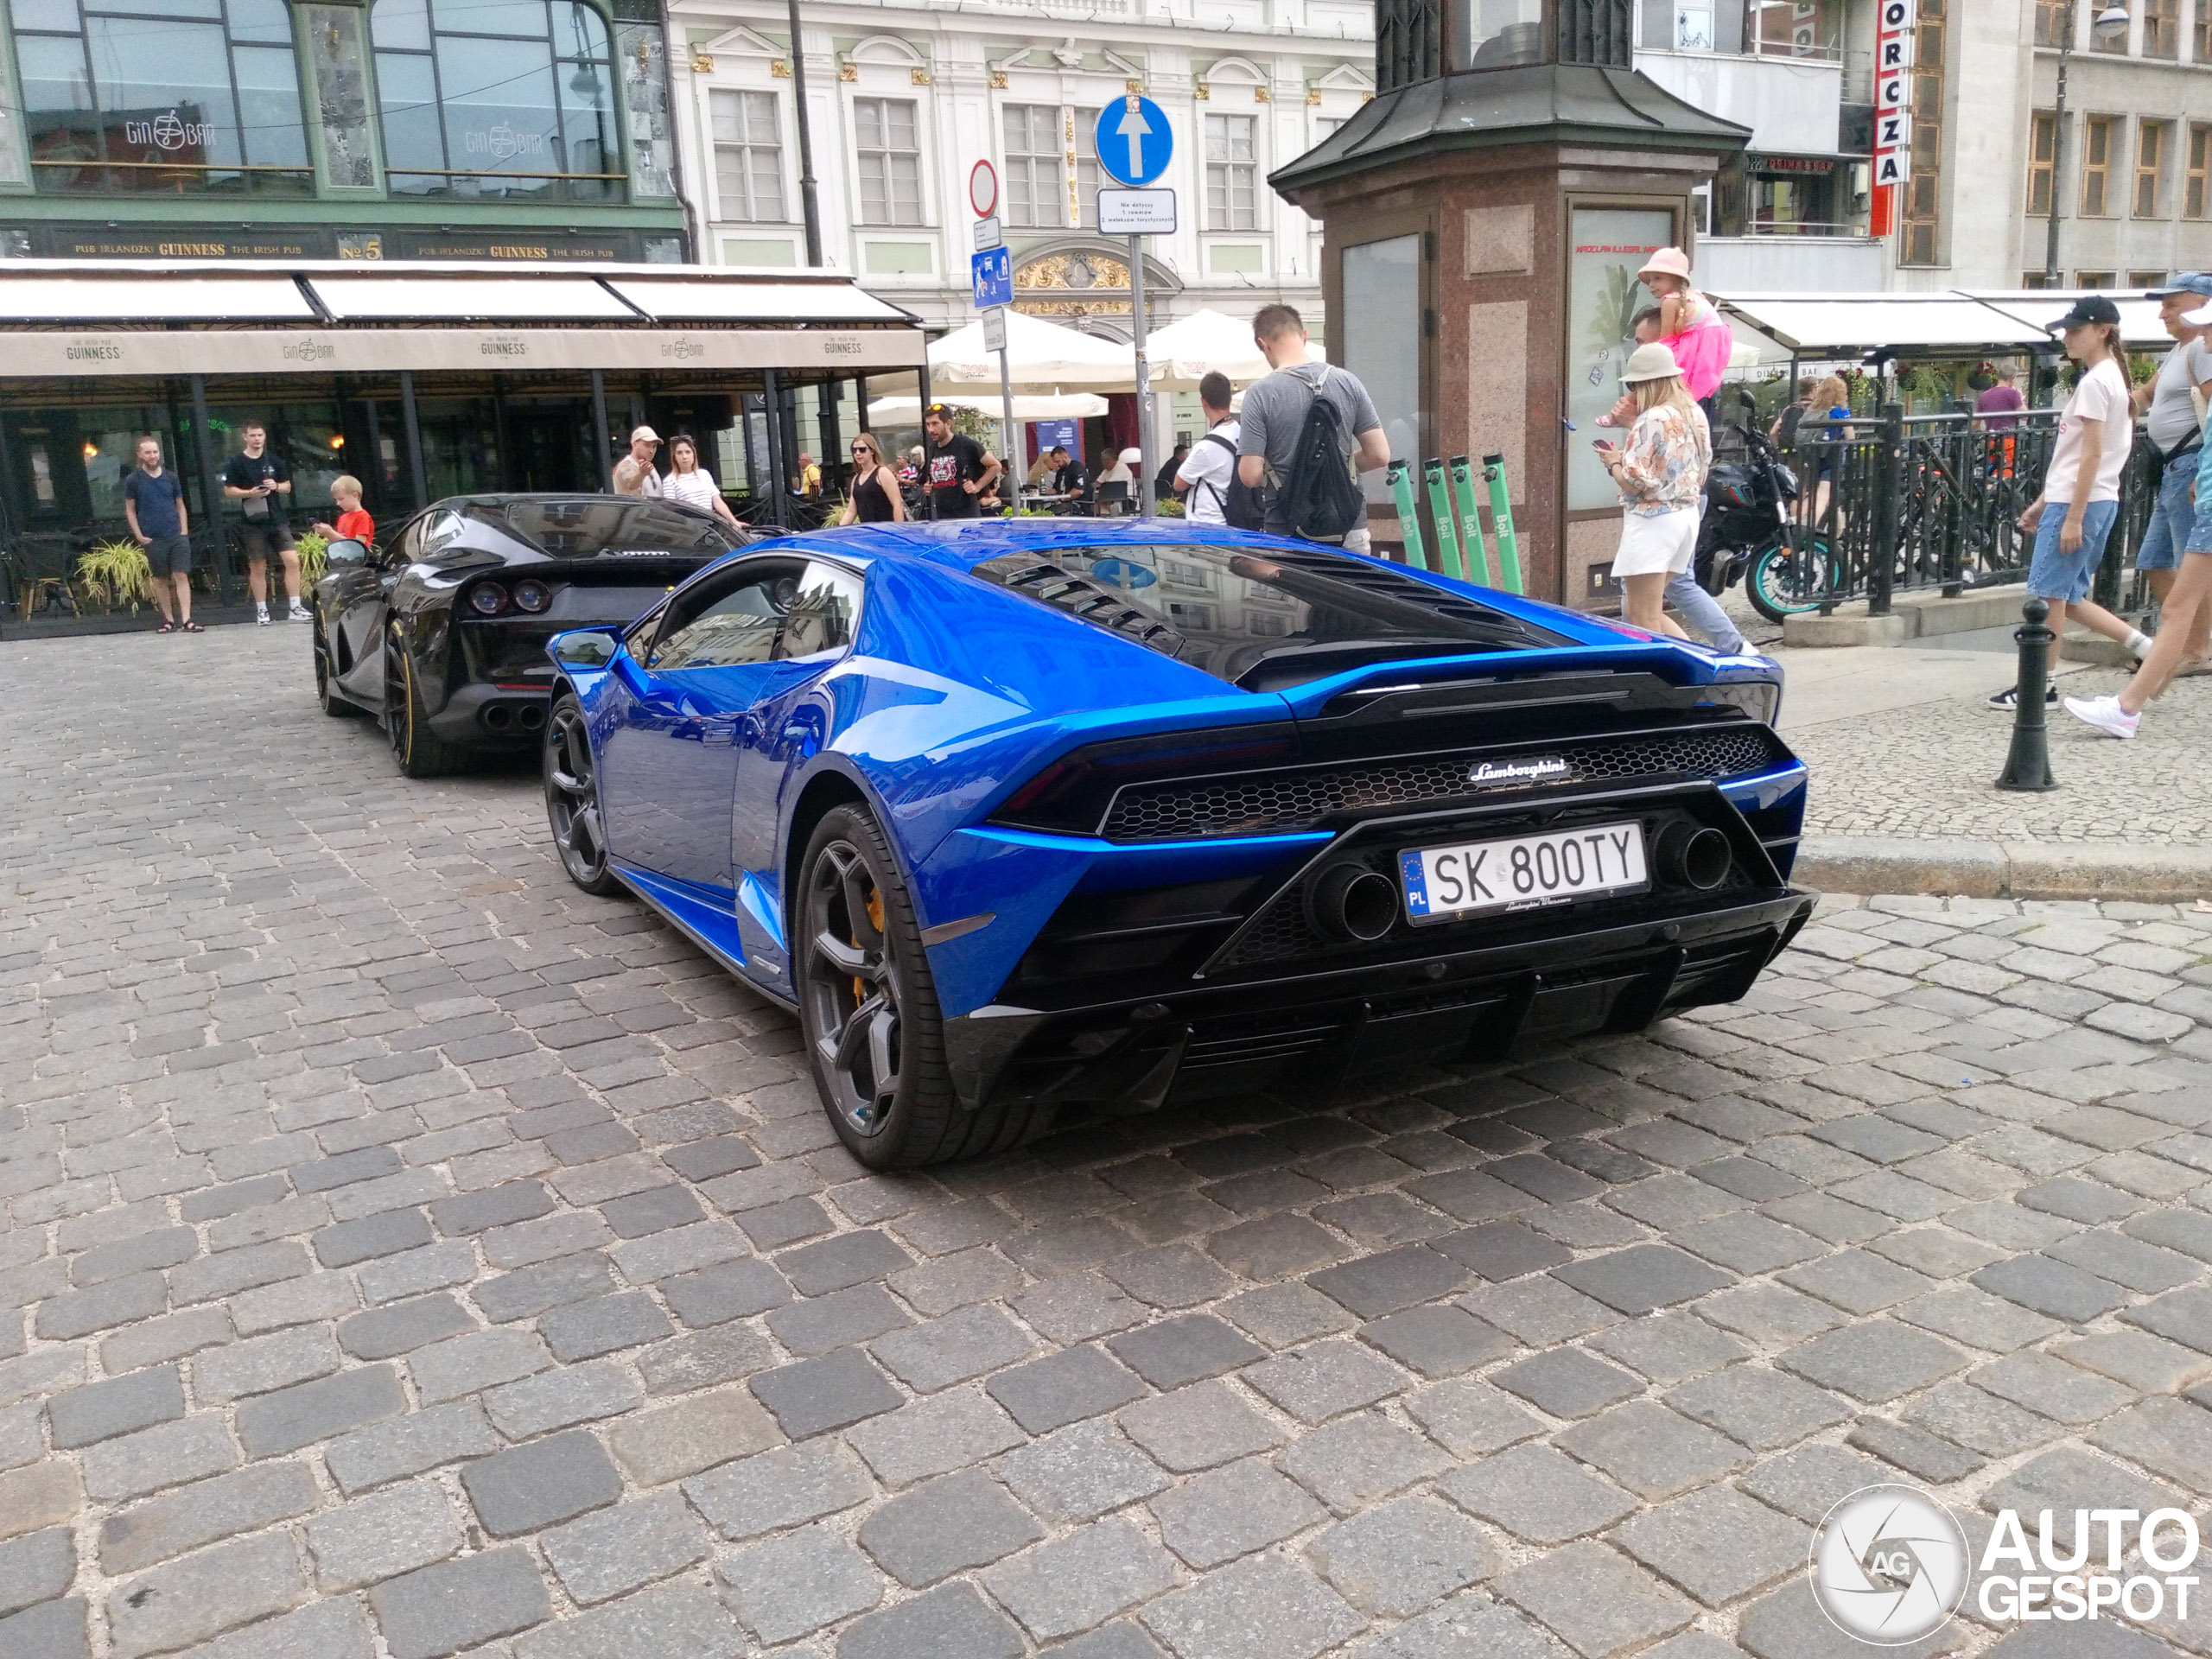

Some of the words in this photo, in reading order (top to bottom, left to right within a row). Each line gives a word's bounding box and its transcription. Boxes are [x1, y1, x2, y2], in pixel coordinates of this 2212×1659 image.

[186, 124, 216, 145] BAR
[517, 134, 543, 154] BAR
[158, 243, 226, 256] GUINNESS
[365, 241, 381, 259] 5
[418, 247, 436, 256] PUB
[490, 245, 548, 258] GUINNESS
[67, 346, 120, 359] GUINNESS
[317, 345, 334, 359] BAR
[481, 342, 525, 354] GUINNESS
[825, 342, 861, 354] GUINNESS
[1402, 514, 1414, 538] Bolt
[1439, 516, 1451, 539] Bolt
[1464, 514, 1478, 538] Bolt
[1496, 513, 1510, 538] Bolt
[1471, 759, 1567, 781] Lamborghini
[1435, 849, 1495, 905] SK
[1510, 830, 1630, 893] 800TY
[1408, 891, 1427, 906] PL
[1505, 901, 1540, 912] Lamborghini
